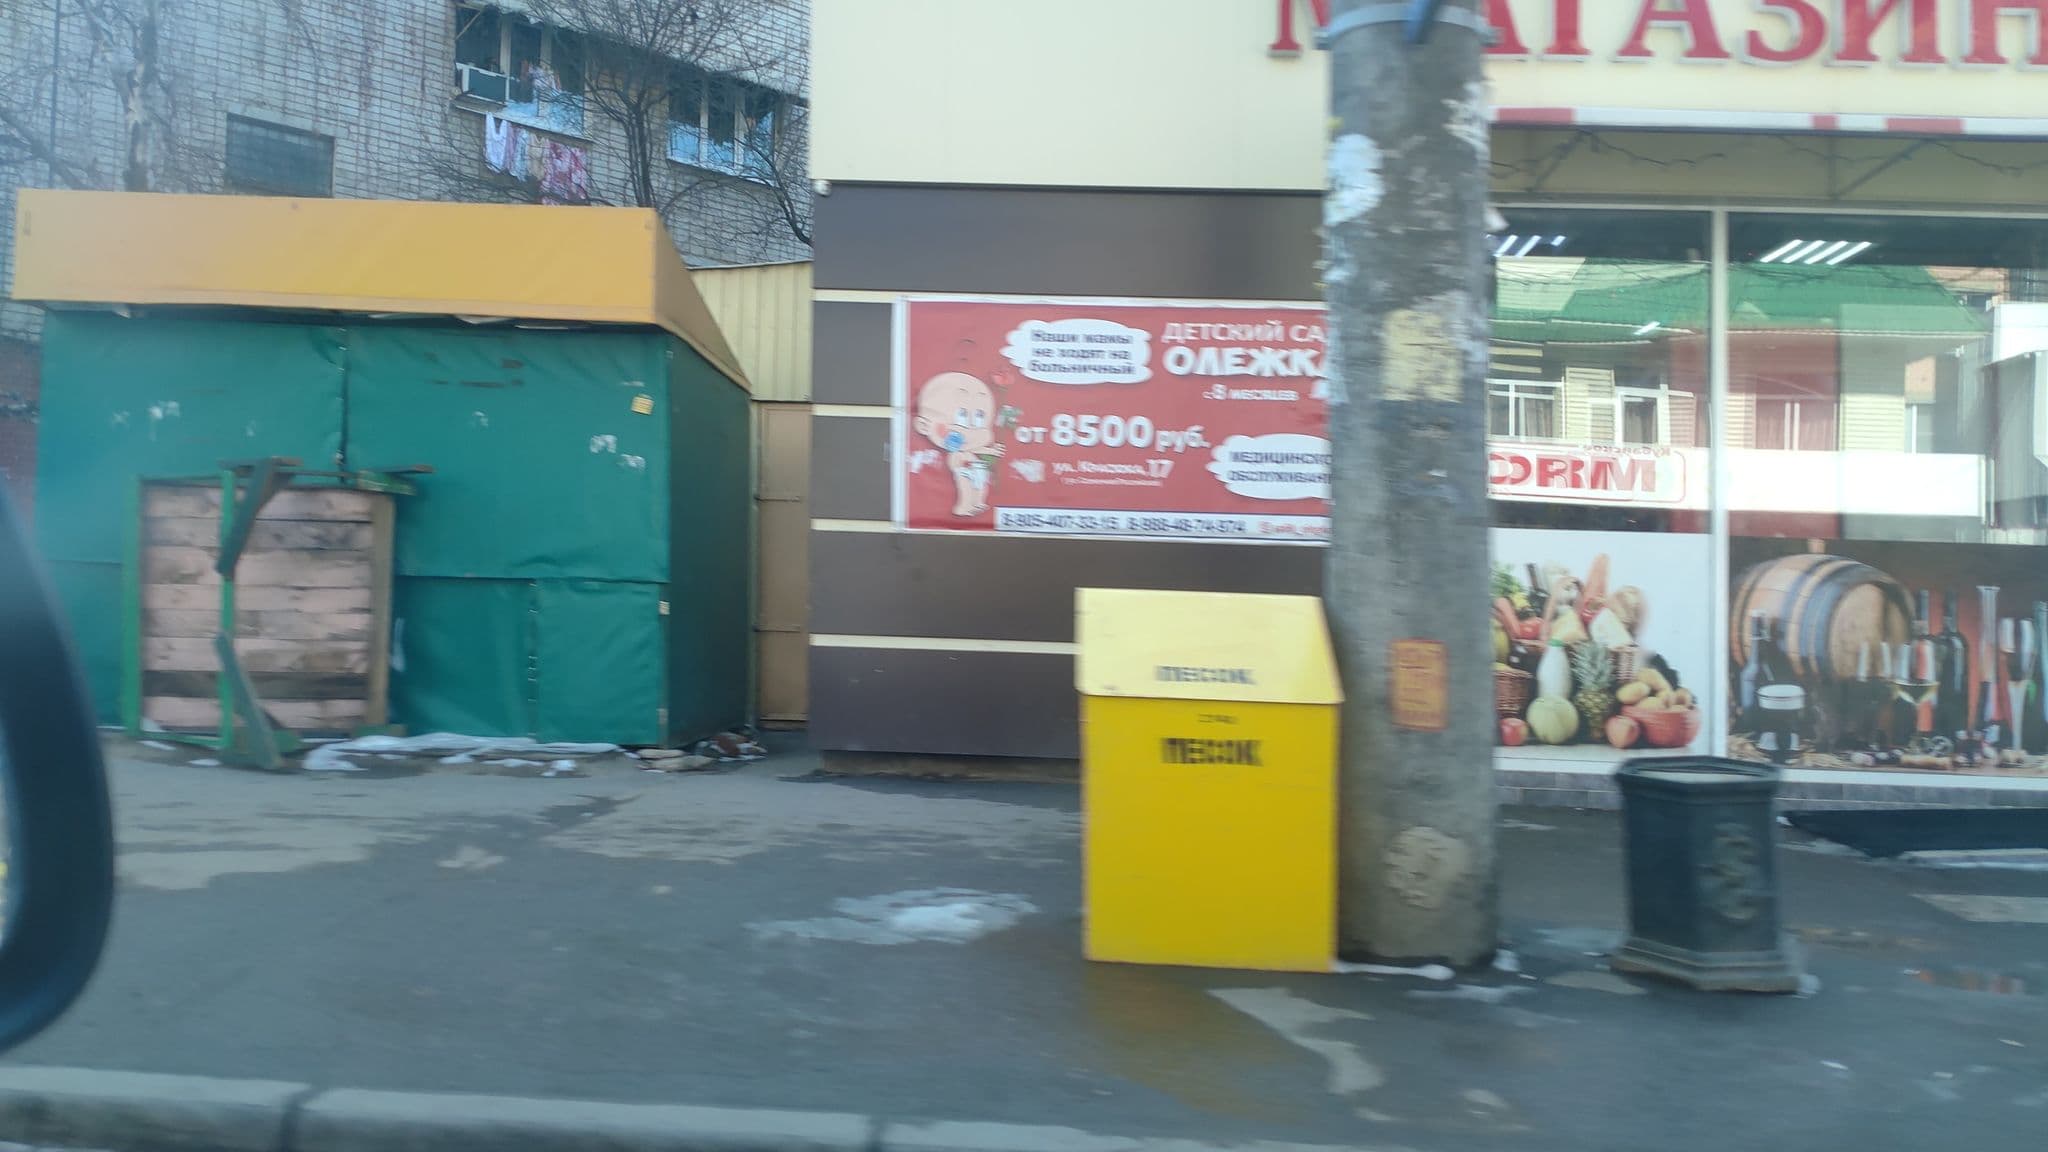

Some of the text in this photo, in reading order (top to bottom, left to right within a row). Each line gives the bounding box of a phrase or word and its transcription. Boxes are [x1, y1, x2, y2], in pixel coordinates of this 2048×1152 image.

[1268, 0, 2048, 65] ГАЗИН
[1161, 320, 1329, 343] ДЕТСКИЙ СА
[1031, 347, 1054, 358] не
[1108, 350, 1131, 361] на
[1028, 360, 1137, 375] больничный
[1015, 413, 1212, 454] от 8500 руб.
[1228, 451, 1333, 465] МЕДИЦИНСКО
[1156, 665, 1257, 685] ПЕСОК
[1161, 737, 1265, 767] ПЕСОК
